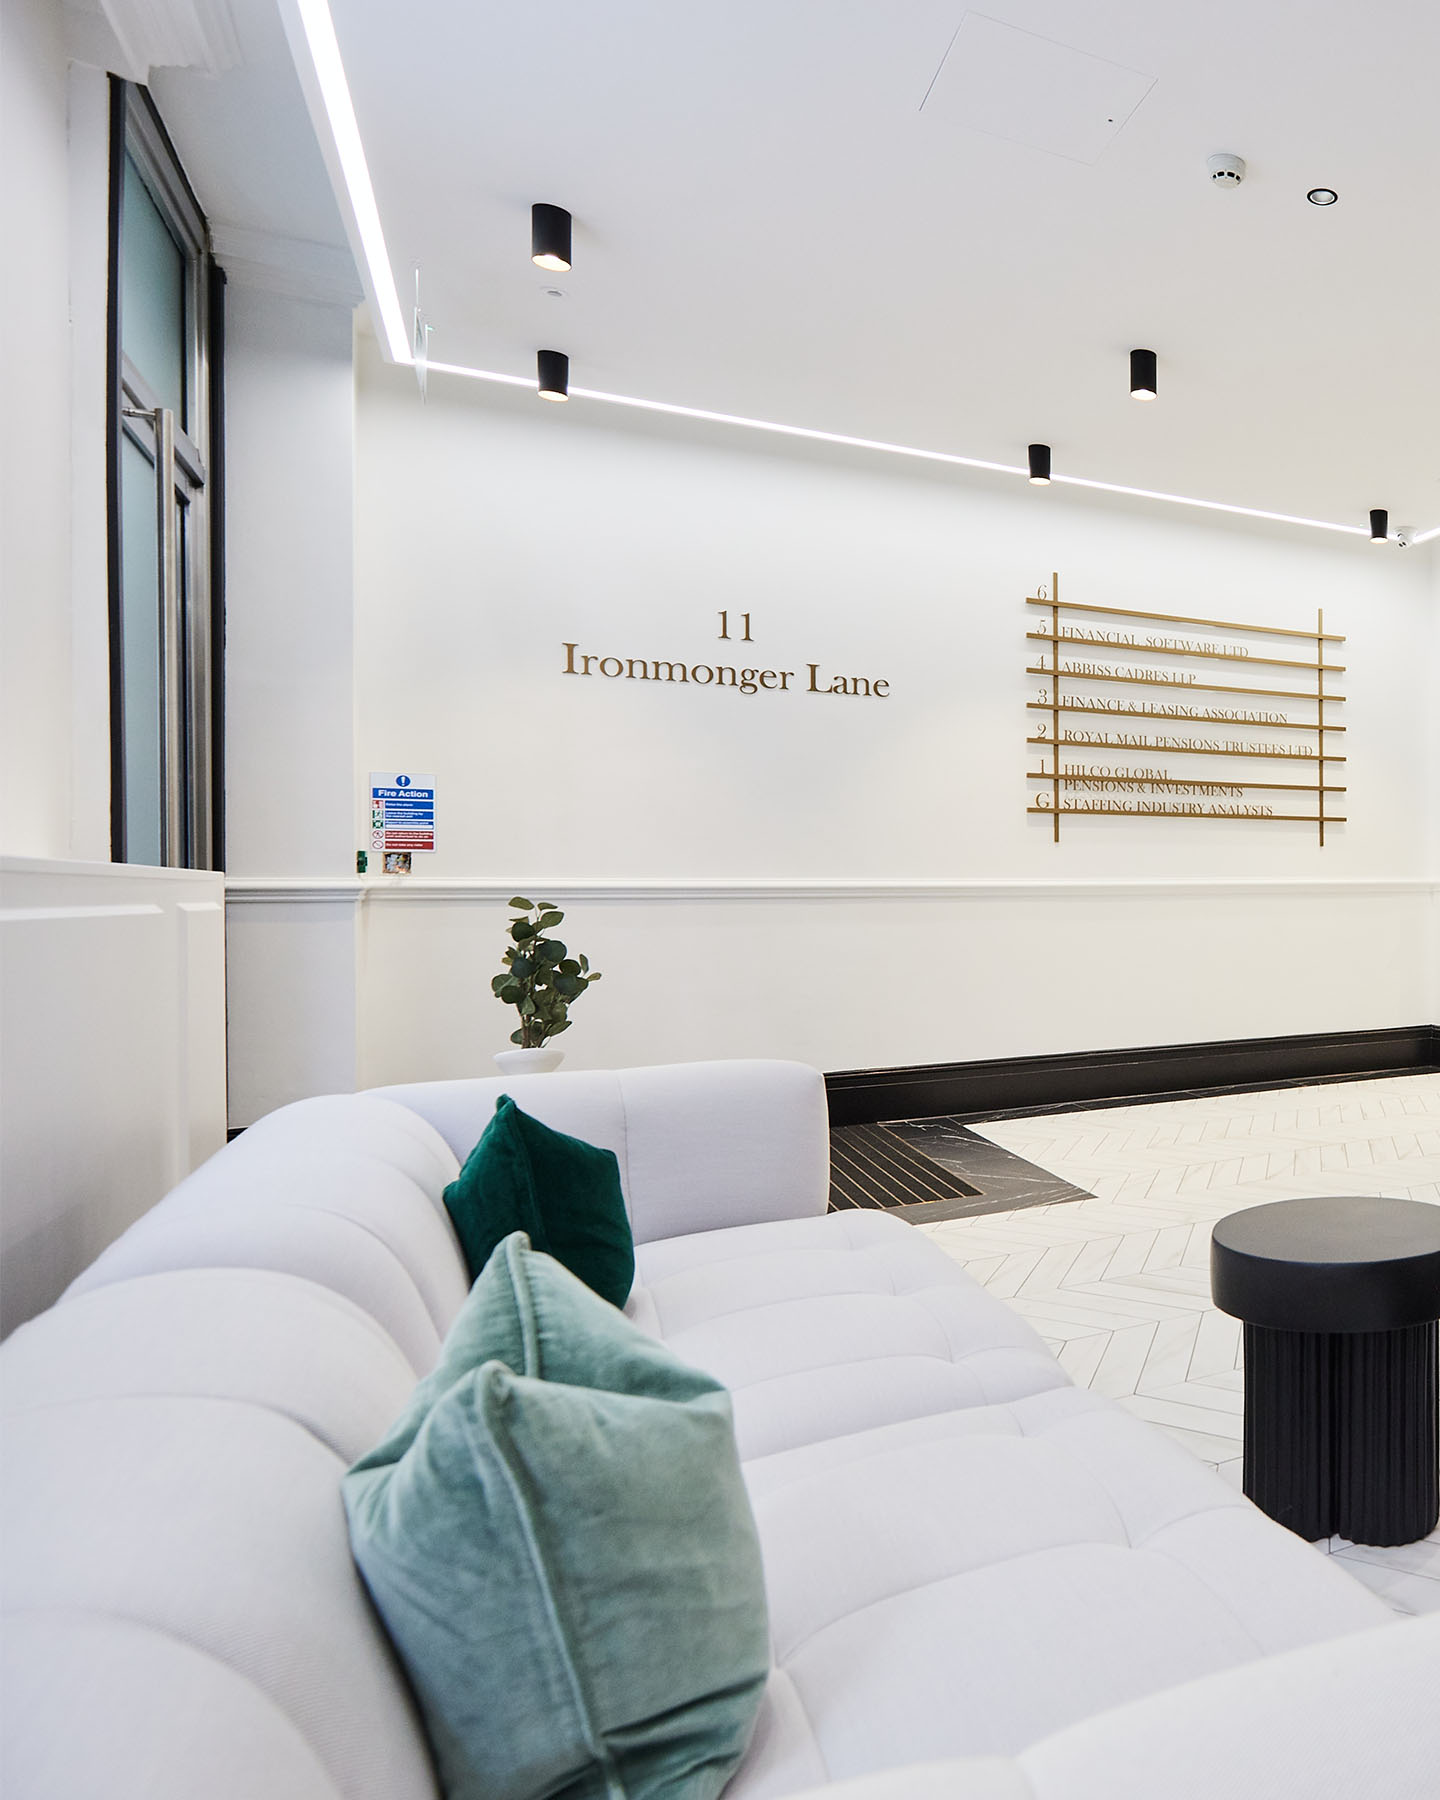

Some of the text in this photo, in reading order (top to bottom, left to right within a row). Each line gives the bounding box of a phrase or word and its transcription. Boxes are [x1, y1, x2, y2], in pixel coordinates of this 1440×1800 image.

[1037, 584, 1047, 600] 6
[717, 610, 754, 642] 11
[1036, 619, 1249, 658] 5 FINANCIAL SOFTWARE LTD
[562, 642, 890, 698] Ironmonger Lane
[1035, 655, 1197, 685] 4 ABBISS CADRES LLP
[1037, 688, 1288, 724] 3 FINANCE & LEASING ASSOCIATION
[1037, 723, 1313, 756] 2 ROYAL MAIL PENSIONS TRUSTEES LTD
[1039, 759, 1172, 781] 1 HILCO GLOBAL
[378, 789, 428, 799] Fire Action
[1064, 779, 1243, 798] PENSIONS & INVESTMENTS
[1035, 792, 1273, 816] G STAFFING INDUSTRY ANALYSTS
